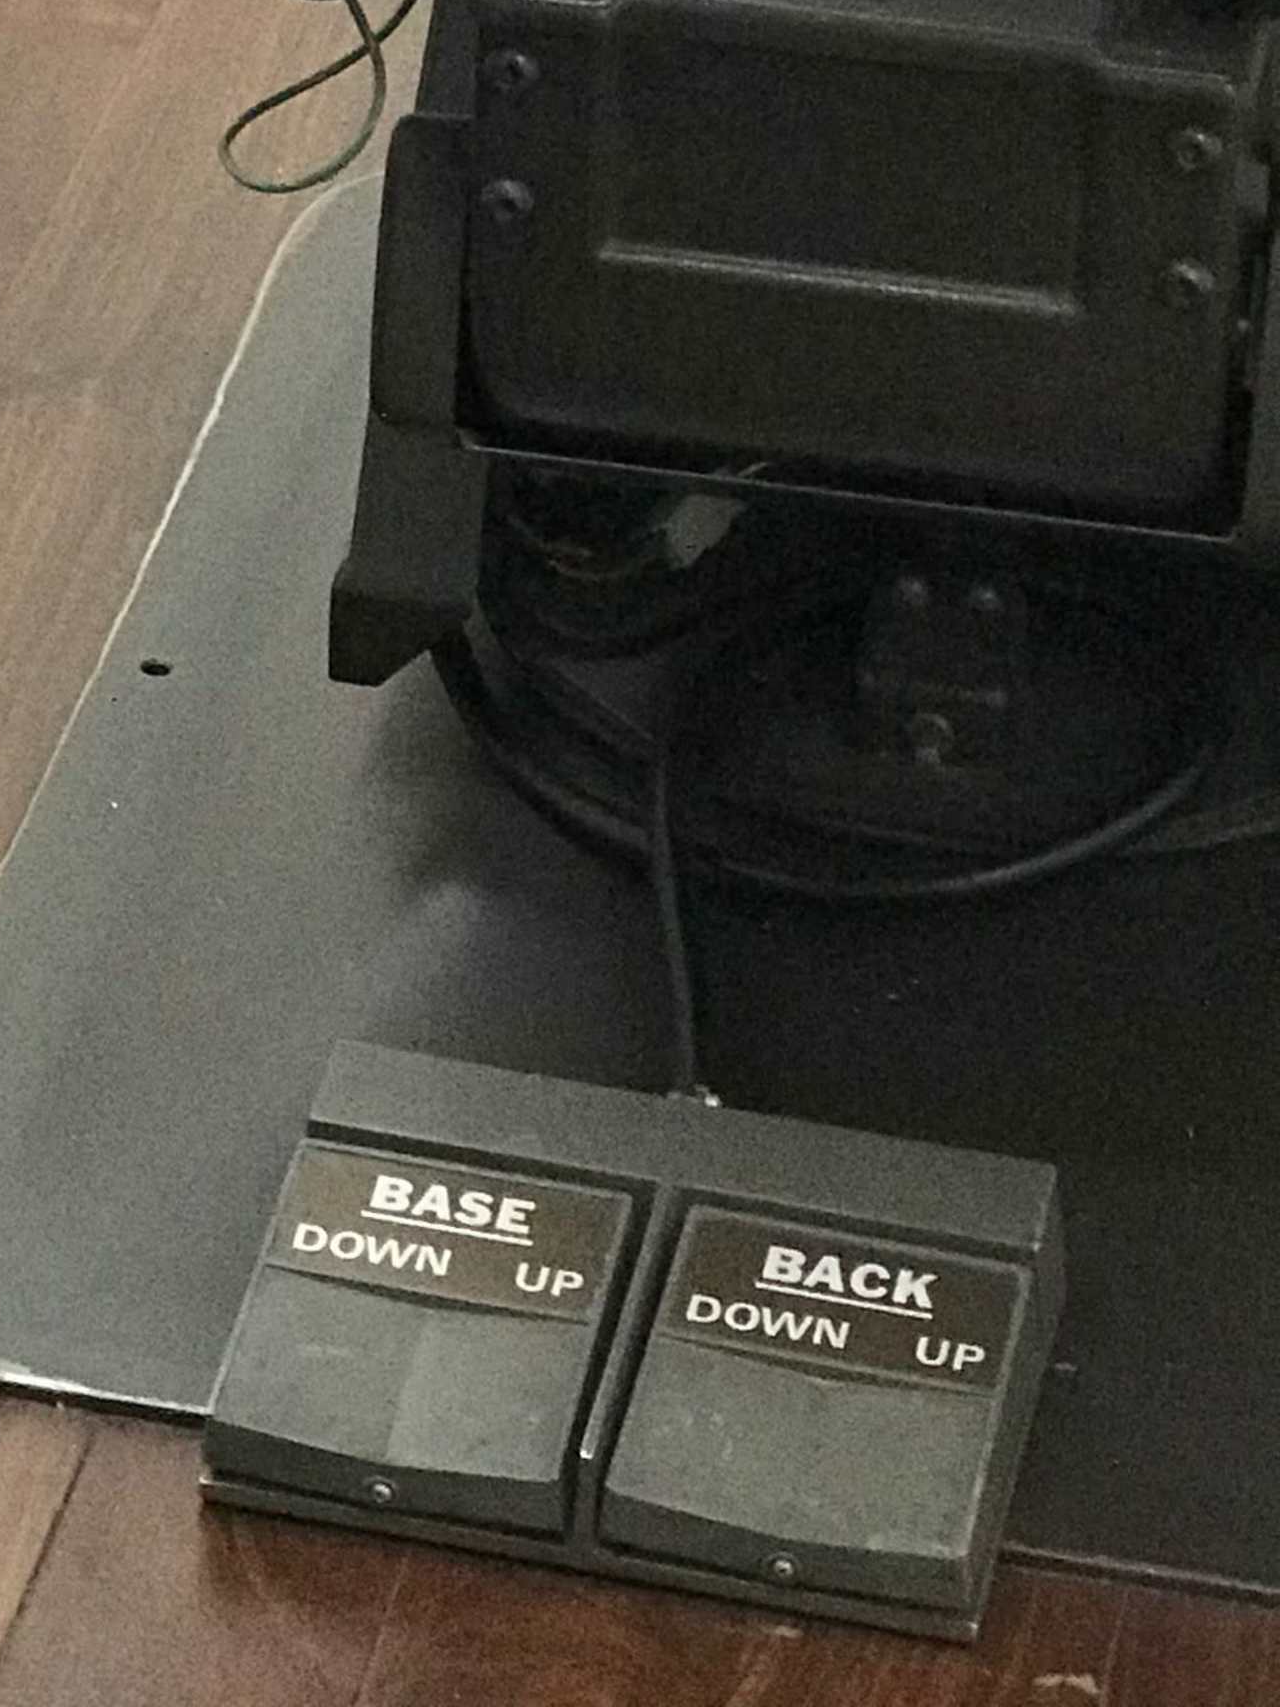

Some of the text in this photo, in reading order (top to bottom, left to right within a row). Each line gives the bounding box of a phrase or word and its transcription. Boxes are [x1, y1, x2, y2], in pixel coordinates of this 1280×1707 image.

[369, 1174, 537, 1236] BASE
[292, 1222, 584, 1297] DOWN UP
[762, 1245, 939, 1309] BACK
[686, 1293, 986, 1371] DOWN UP
